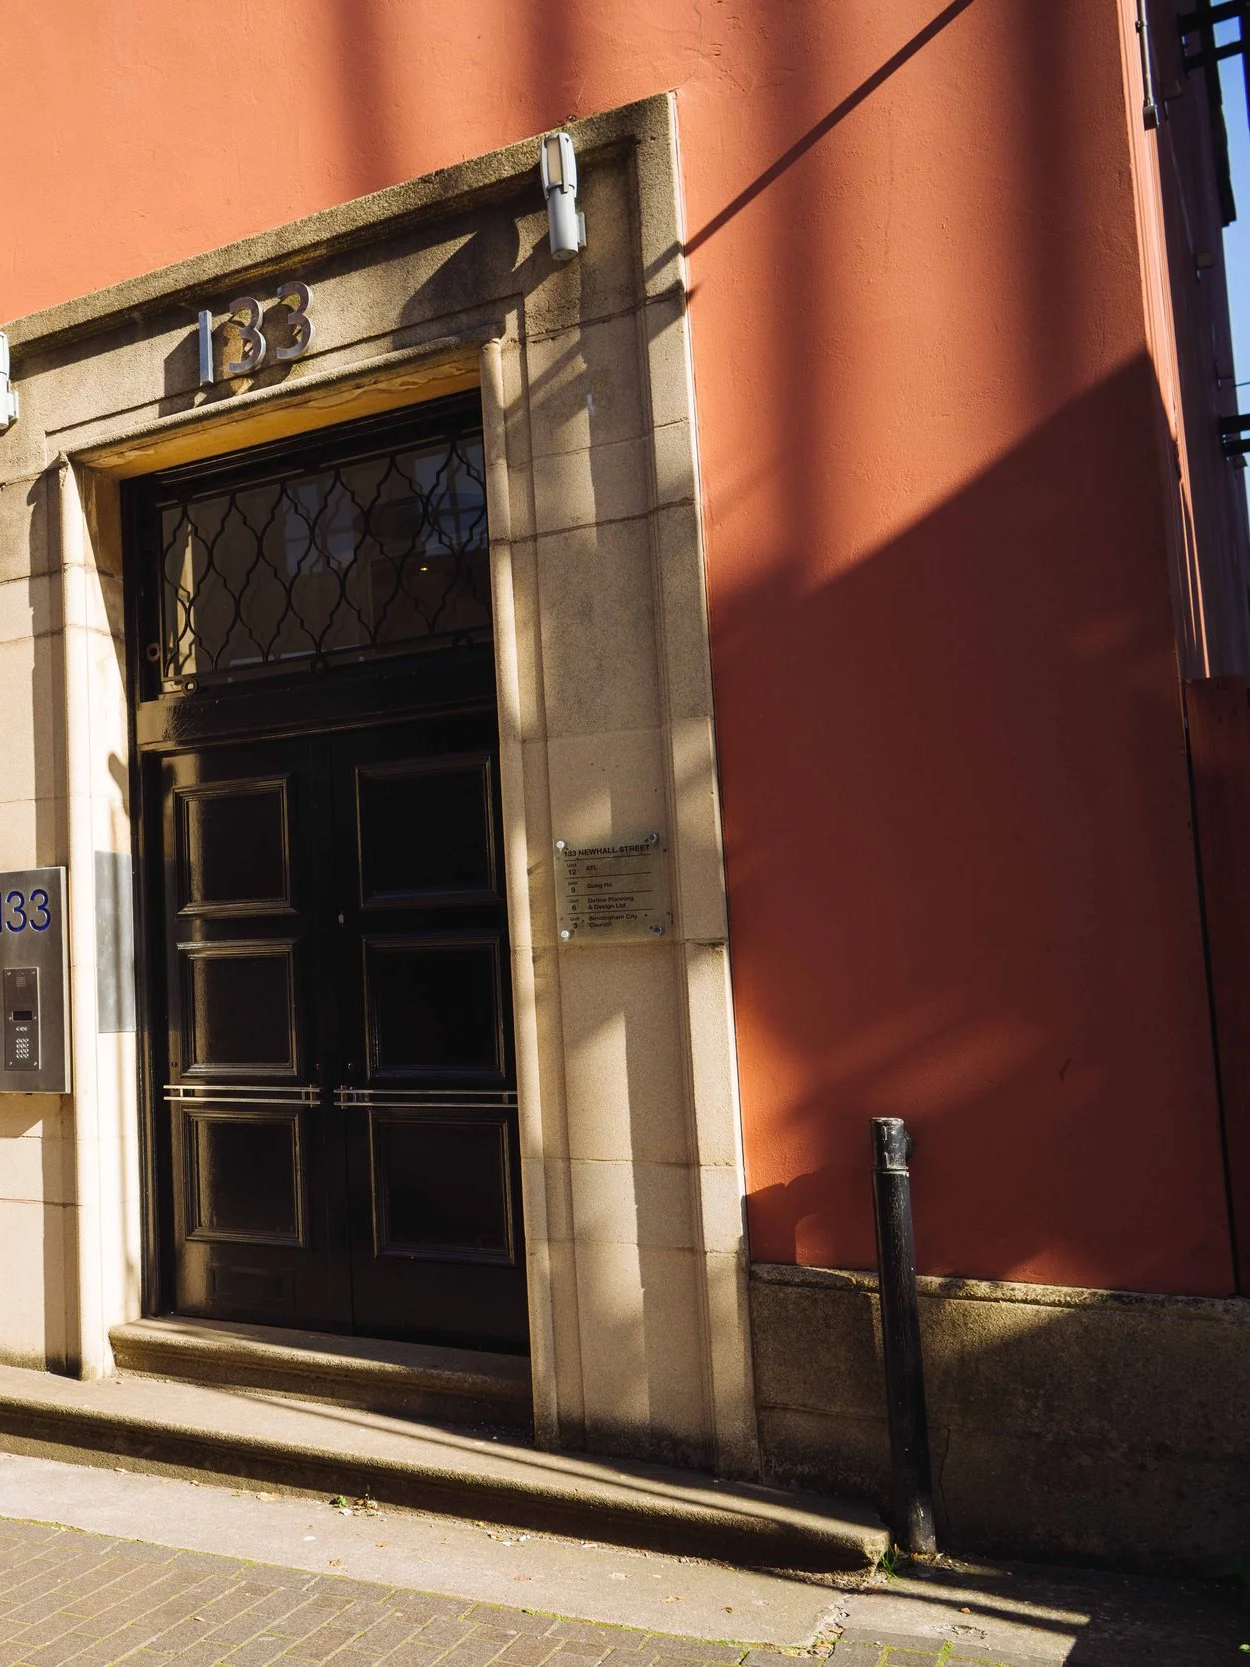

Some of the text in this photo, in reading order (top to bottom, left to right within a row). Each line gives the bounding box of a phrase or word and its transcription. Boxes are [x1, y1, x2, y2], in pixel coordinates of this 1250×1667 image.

[198, 280, 316, 385] 133
[578, 847, 618, 856] NEWHALL
[618, 844, 650, 853] STREET
